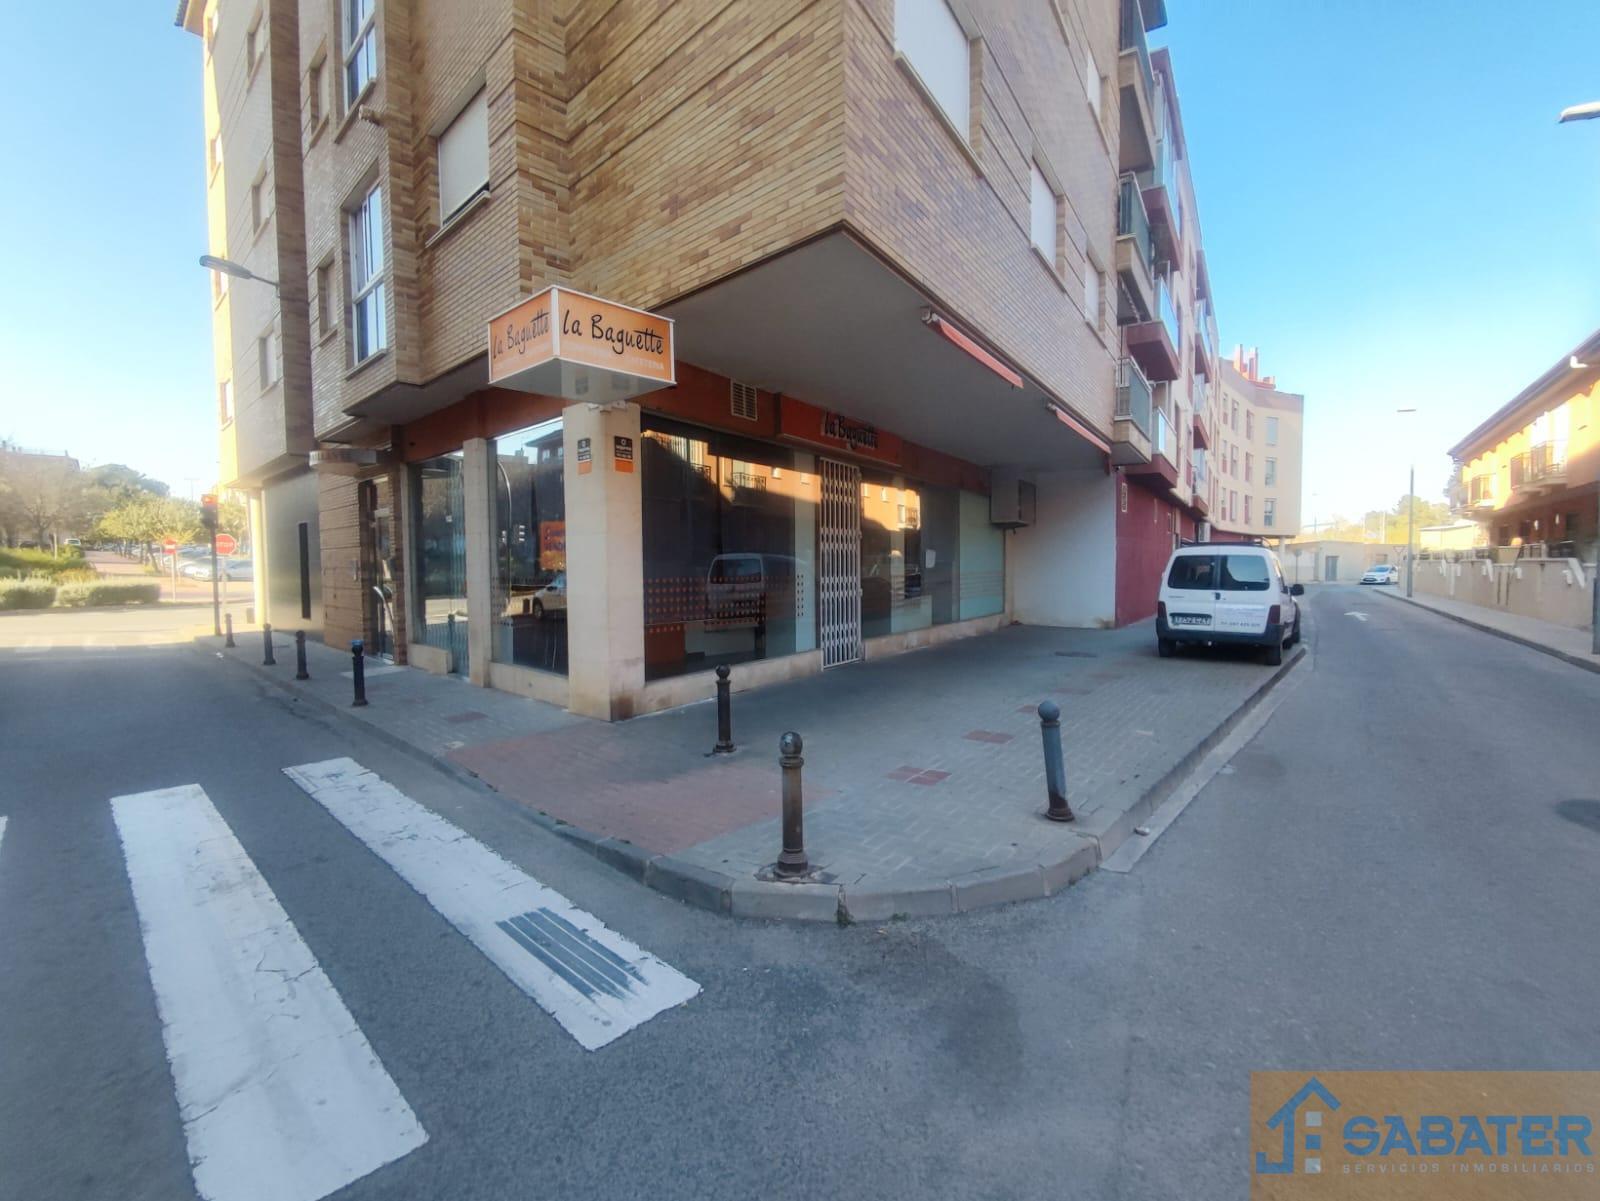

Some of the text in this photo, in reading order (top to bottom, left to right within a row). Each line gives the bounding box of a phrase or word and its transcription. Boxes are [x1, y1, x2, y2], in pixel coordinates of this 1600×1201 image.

[493, 335, 504, 360] la
[507, 309, 550, 355] Baguette
[562, 309, 583, 337] la
[591, 314, 664, 355] Baguette
